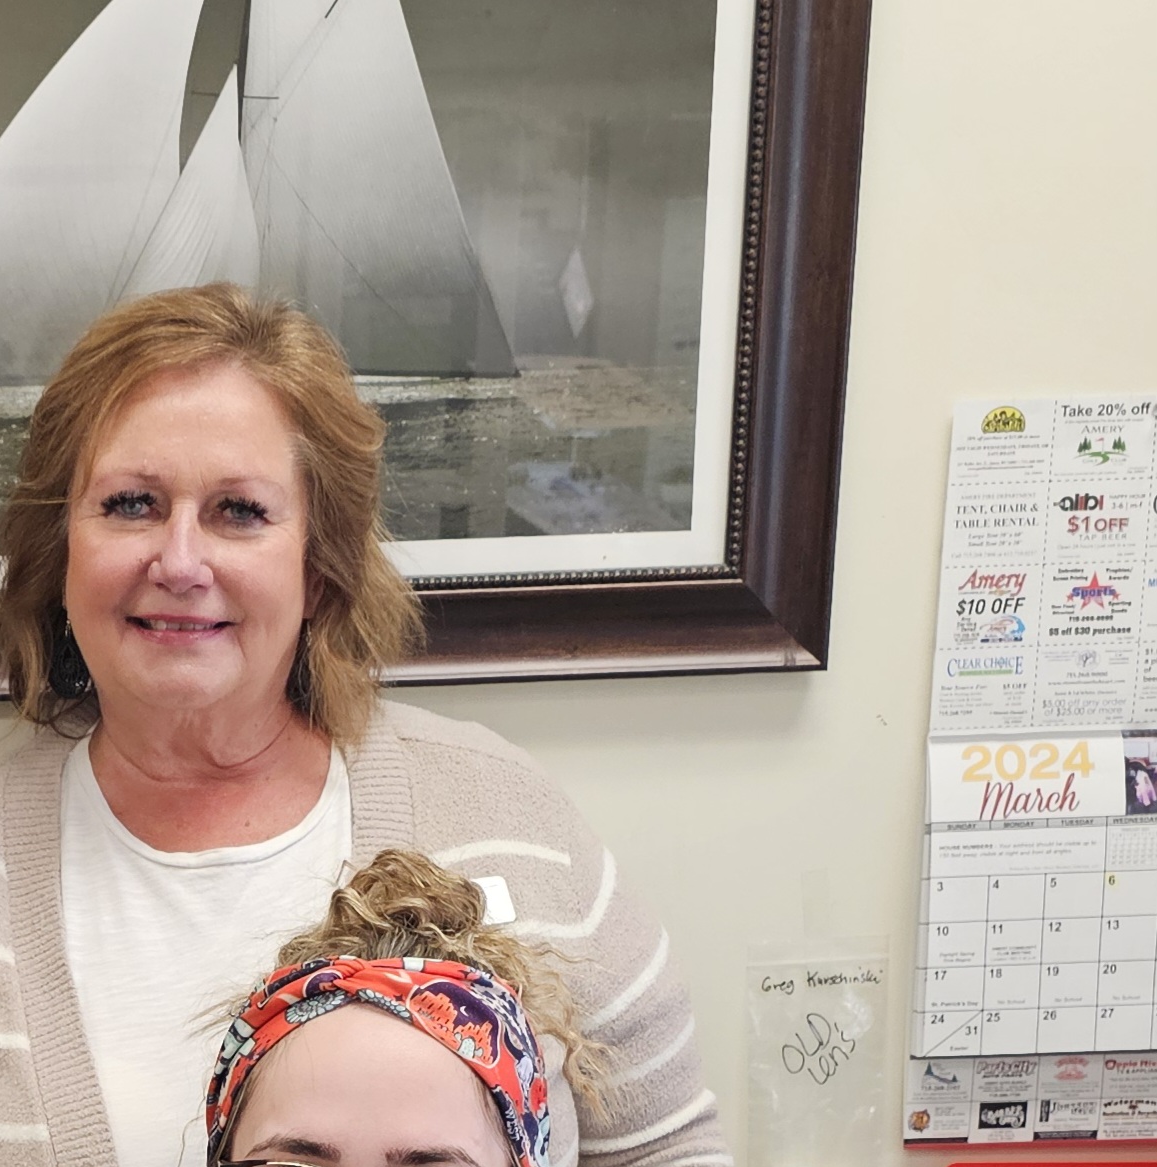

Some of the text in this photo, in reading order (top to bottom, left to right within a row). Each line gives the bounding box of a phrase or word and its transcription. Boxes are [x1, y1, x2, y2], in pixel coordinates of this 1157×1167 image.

[1061, 402, 1151, 417] Take 20% off
[1082, 425, 1124, 434] AMERY
[957, 503, 1039, 514] TENT, CHAIR &
[954, 517, 1039, 529] TABLE RENTAL
[1067, 515, 1129, 536] $1 OFF
[958, 569, 1027, 597] Amery
[1072, 586, 1117, 600] Sports
[956, 597, 1026, 616] $10 OFF
[1049, 626, 1131, 636] $5 off $30 purchase
[947, 656, 1024, 677] CLEAR CHOICE
[961, 741, 1095, 783] 2024
[980, 772, 1080, 821] March
[937, 875, 1115, 891] 3 4 5 6
[936, 920, 1120, 936] 10 11 12 13
[934, 964, 1117, 980] 17 18 19 20
[762, 976, 795, 995] Greg
[931, 1008, 1114, 1024] 24 25 26 27
[965, 1026, 978, 1035] 31
[782, 1012, 832, 1074] OLD
